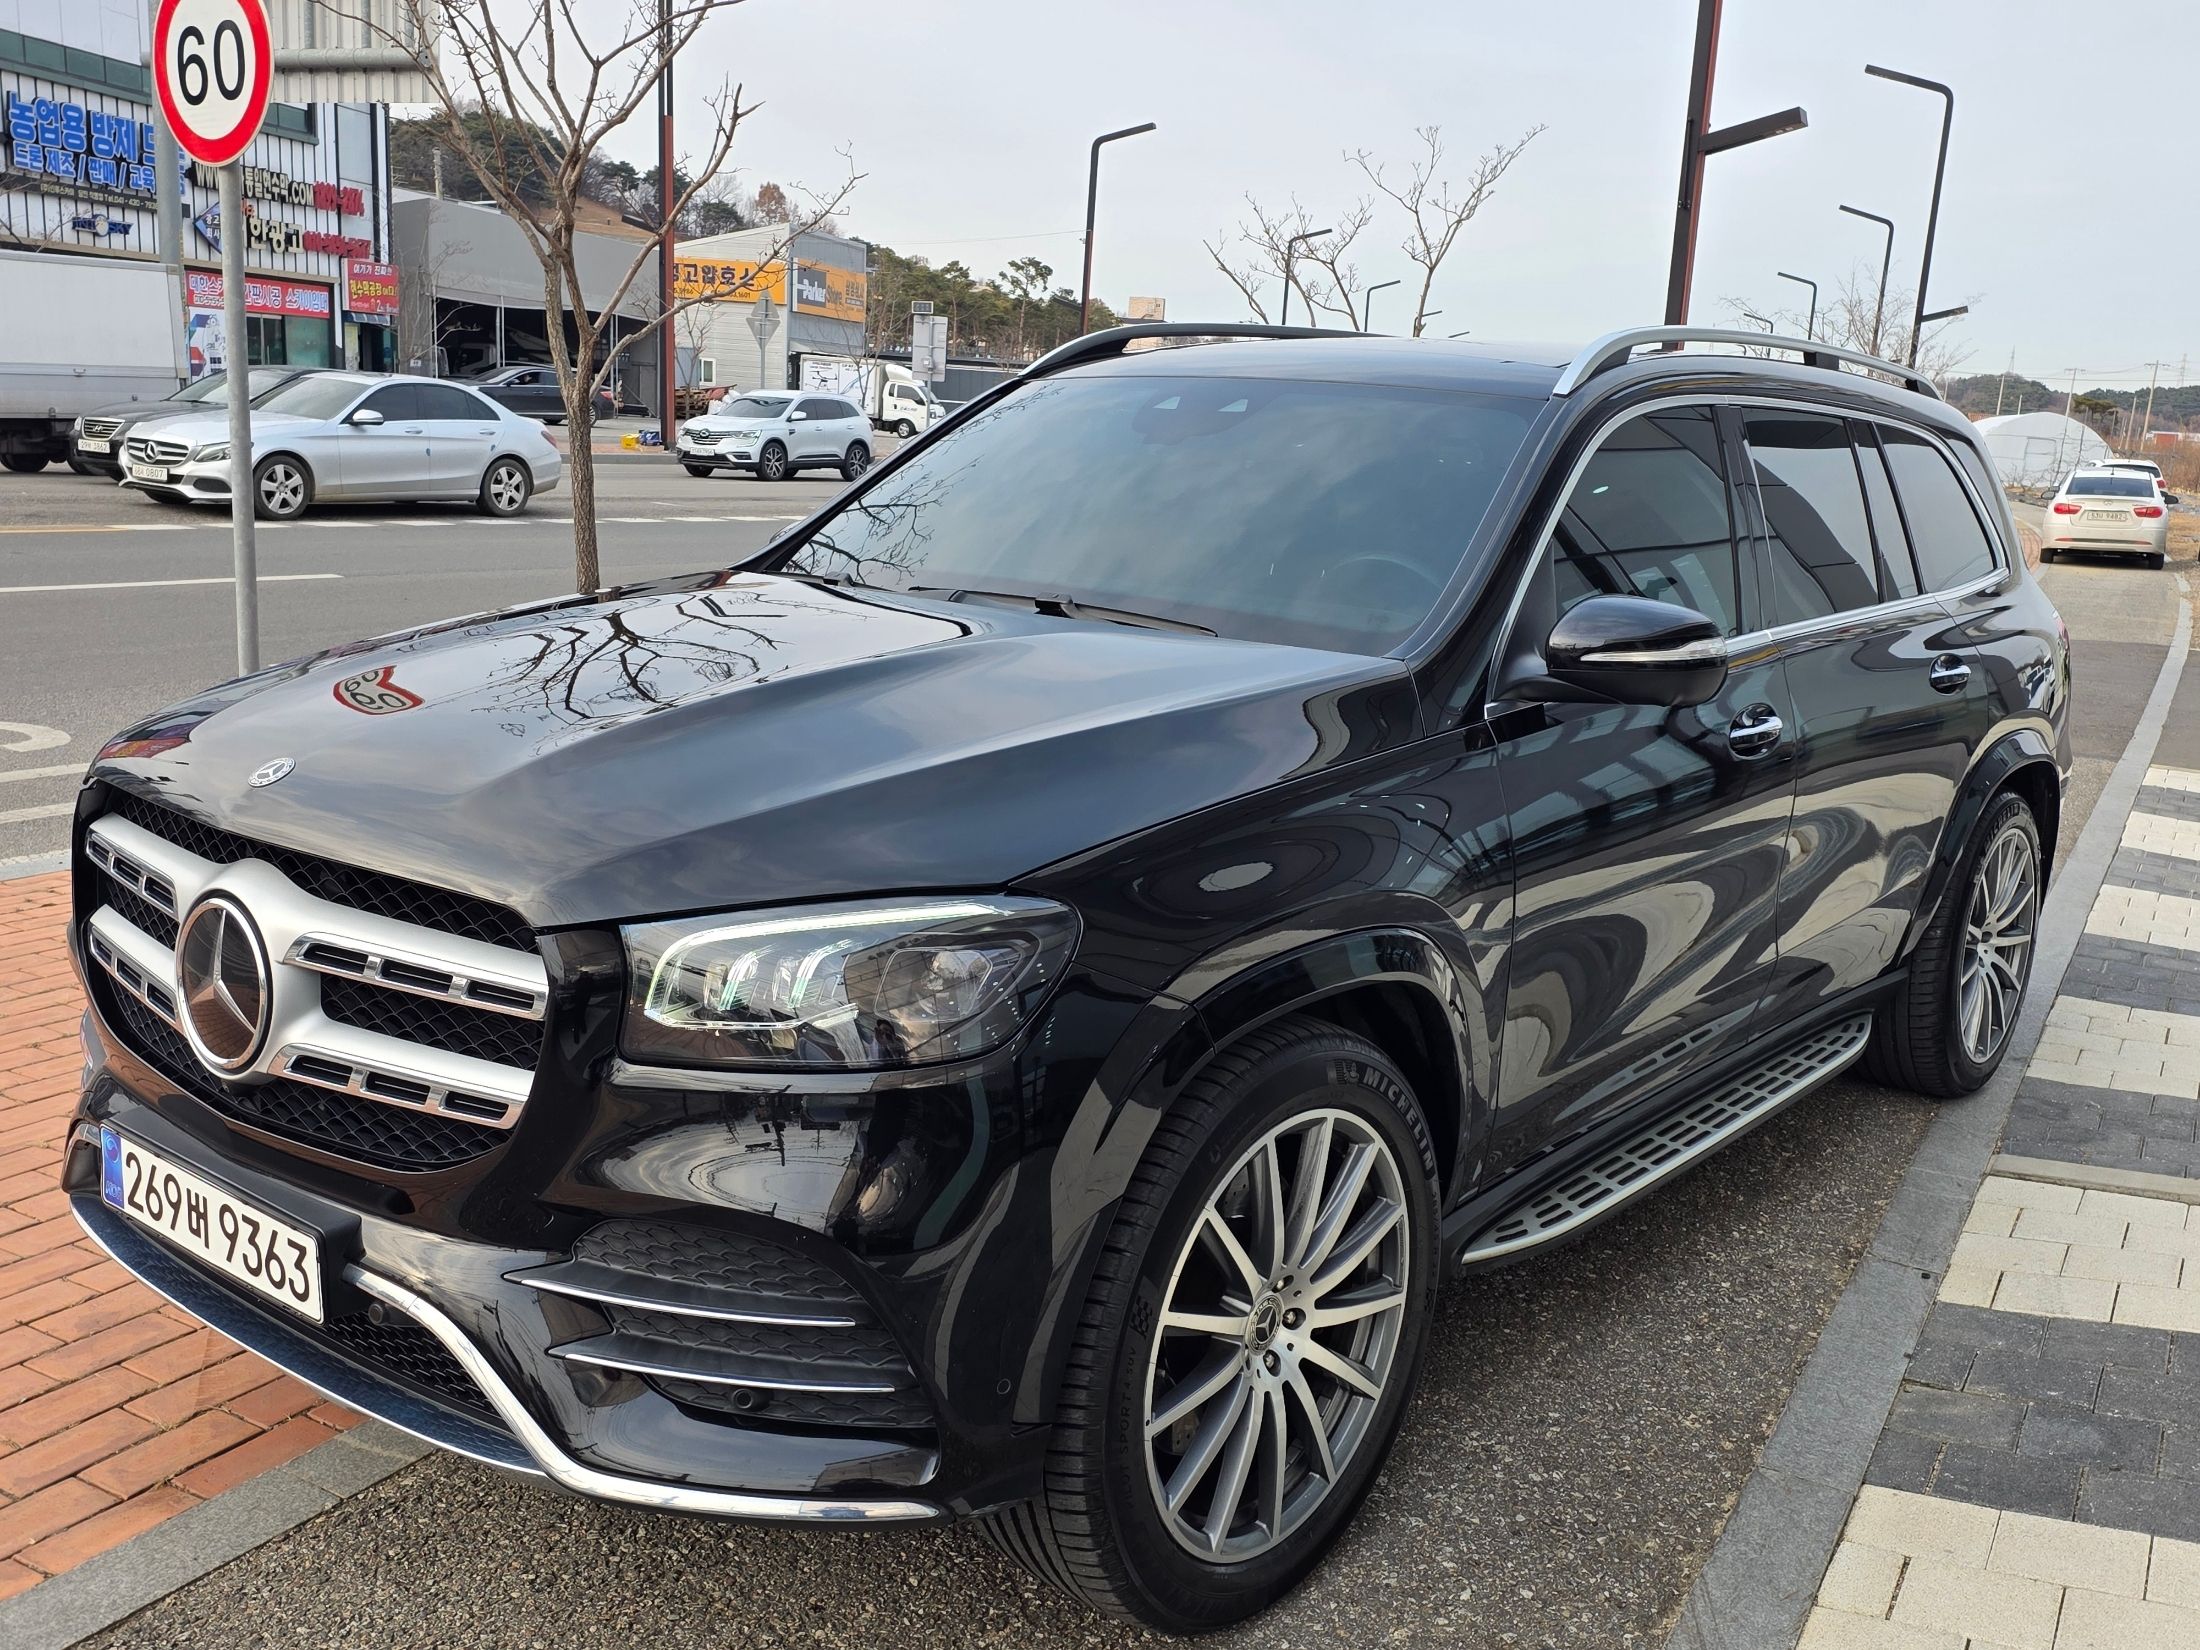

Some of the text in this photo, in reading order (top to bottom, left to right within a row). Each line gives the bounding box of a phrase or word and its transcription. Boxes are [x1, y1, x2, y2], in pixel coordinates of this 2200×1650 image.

[177, 19, 246, 106] 60
[9, 91, 87, 153] 농업용
[89, 110, 139, 164] 방제
[13, 140, 44, 172] 드론
[45, 148, 76, 178] 제조
[88, 156, 118, 187] 판매
[129, 164, 156, 193] 교육
[243, 216, 305, 255] 한광고
[1362, 1066, 1435, 1171] MICHELIN
[125, 1151, 310, 1303] 269버 9363
[1118, 1393, 1133, 1455] SPORT
[1118, 1463, 1136, 1511] PILOT
